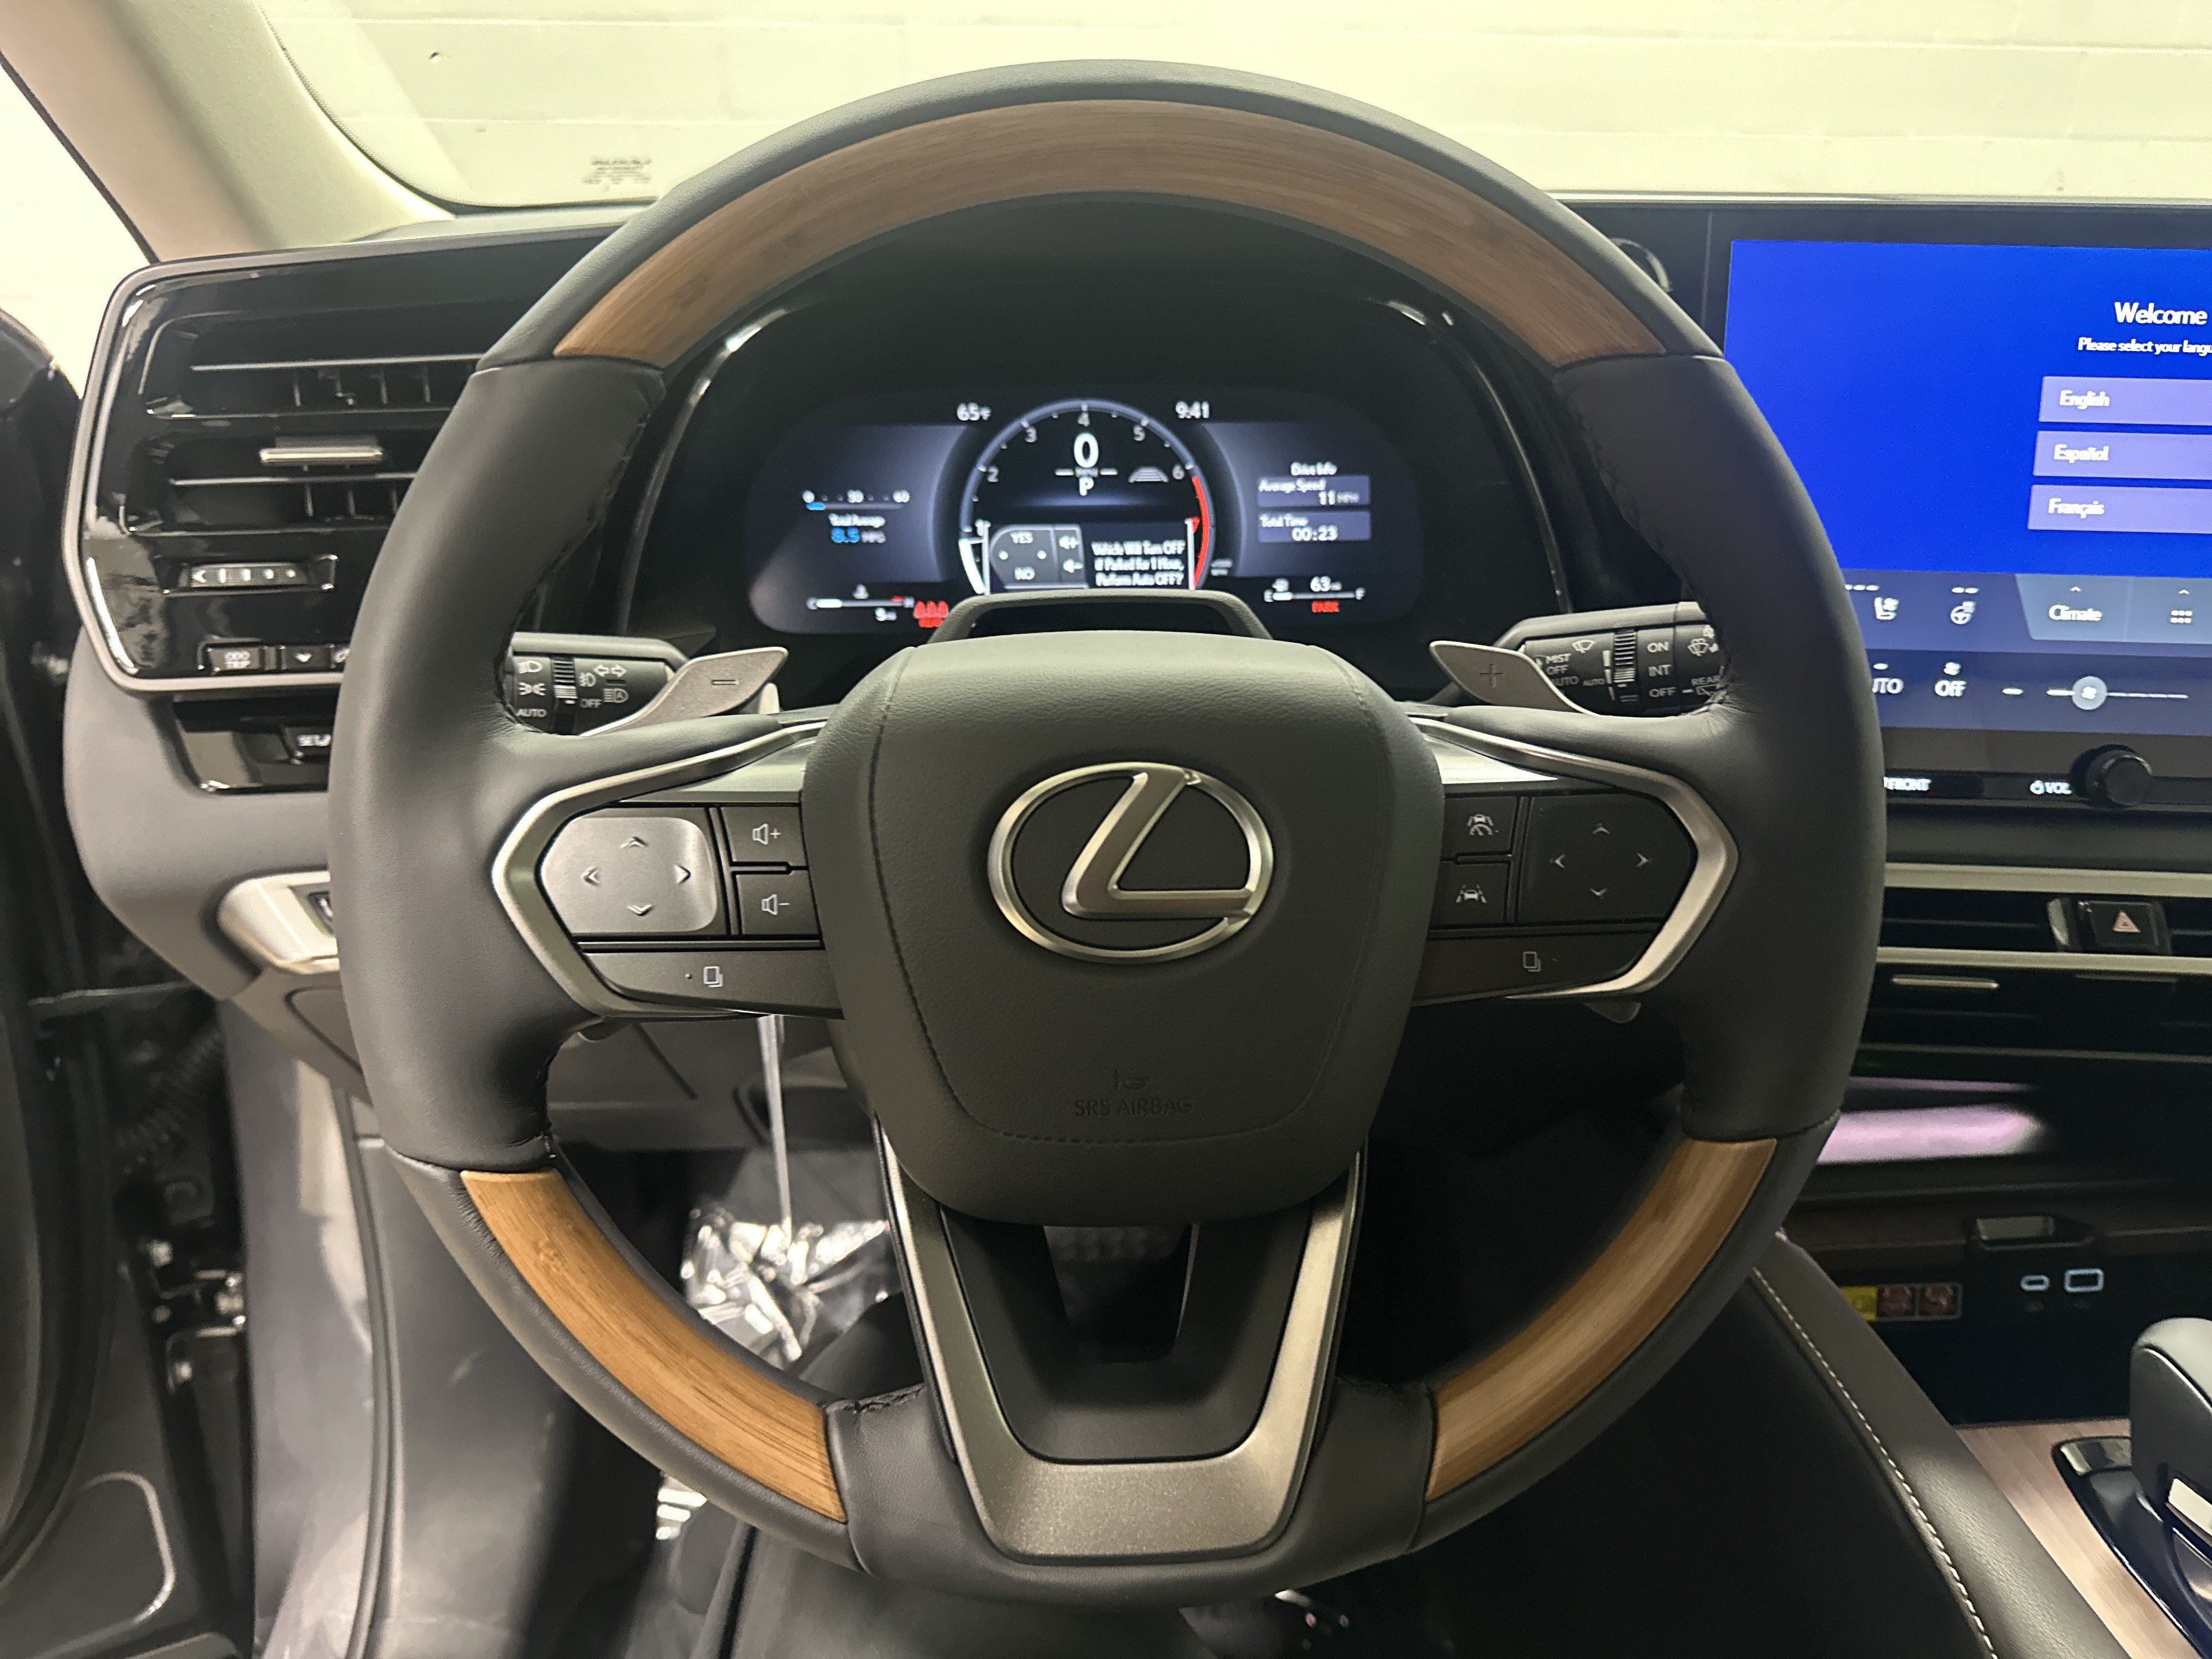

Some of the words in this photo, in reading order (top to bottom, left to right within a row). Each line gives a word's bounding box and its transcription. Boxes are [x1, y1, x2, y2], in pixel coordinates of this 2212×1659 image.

[2114, 302, 2208, 325] Welcome
[2078, 336, 2117, 351] Please
[2118, 338, 2154, 352] select
[2154, 343, 2182, 355] your
[2059, 390, 2110, 409] English
[1175, 400, 1210, 419] 9:41
[1025, 426, 1037, 443] 3
[1133, 424, 1146, 441] 5
[1074, 432, 1099, 467] 0
[2053, 444, 2109, 464] Español
[988, 466, 999, 482] 2
[1172, 464, 1185, 480] 6
[1079, 477, 1094, 496] P
[1318, 490, 1336, 505] 11
[2048, 498, 2105, 518] Français
[1292, 525, 1339, 541] 00:23
[1163, 539, 1186, 555] OFF
[1014, 566, 1035, 580] NO
[1310, 576, 1331, 591] 63
[2049, 605, 2102, 621] Climate
[1647, 641, 1669, 653] ON
[1545, 653, 1571, 664] MIST
[1545, 664, 1570, 675] OFF
[1648, 664, 1672, 677] INT
[1649, 686, 1676, 698] OFF
[580, 698, 602, 708] OFF
[516, 708, 547, 717] AUTO
[1074, 1099, 1111, 1117] SRS
[1116, 1097, 1193, 1116] AIRBAG
